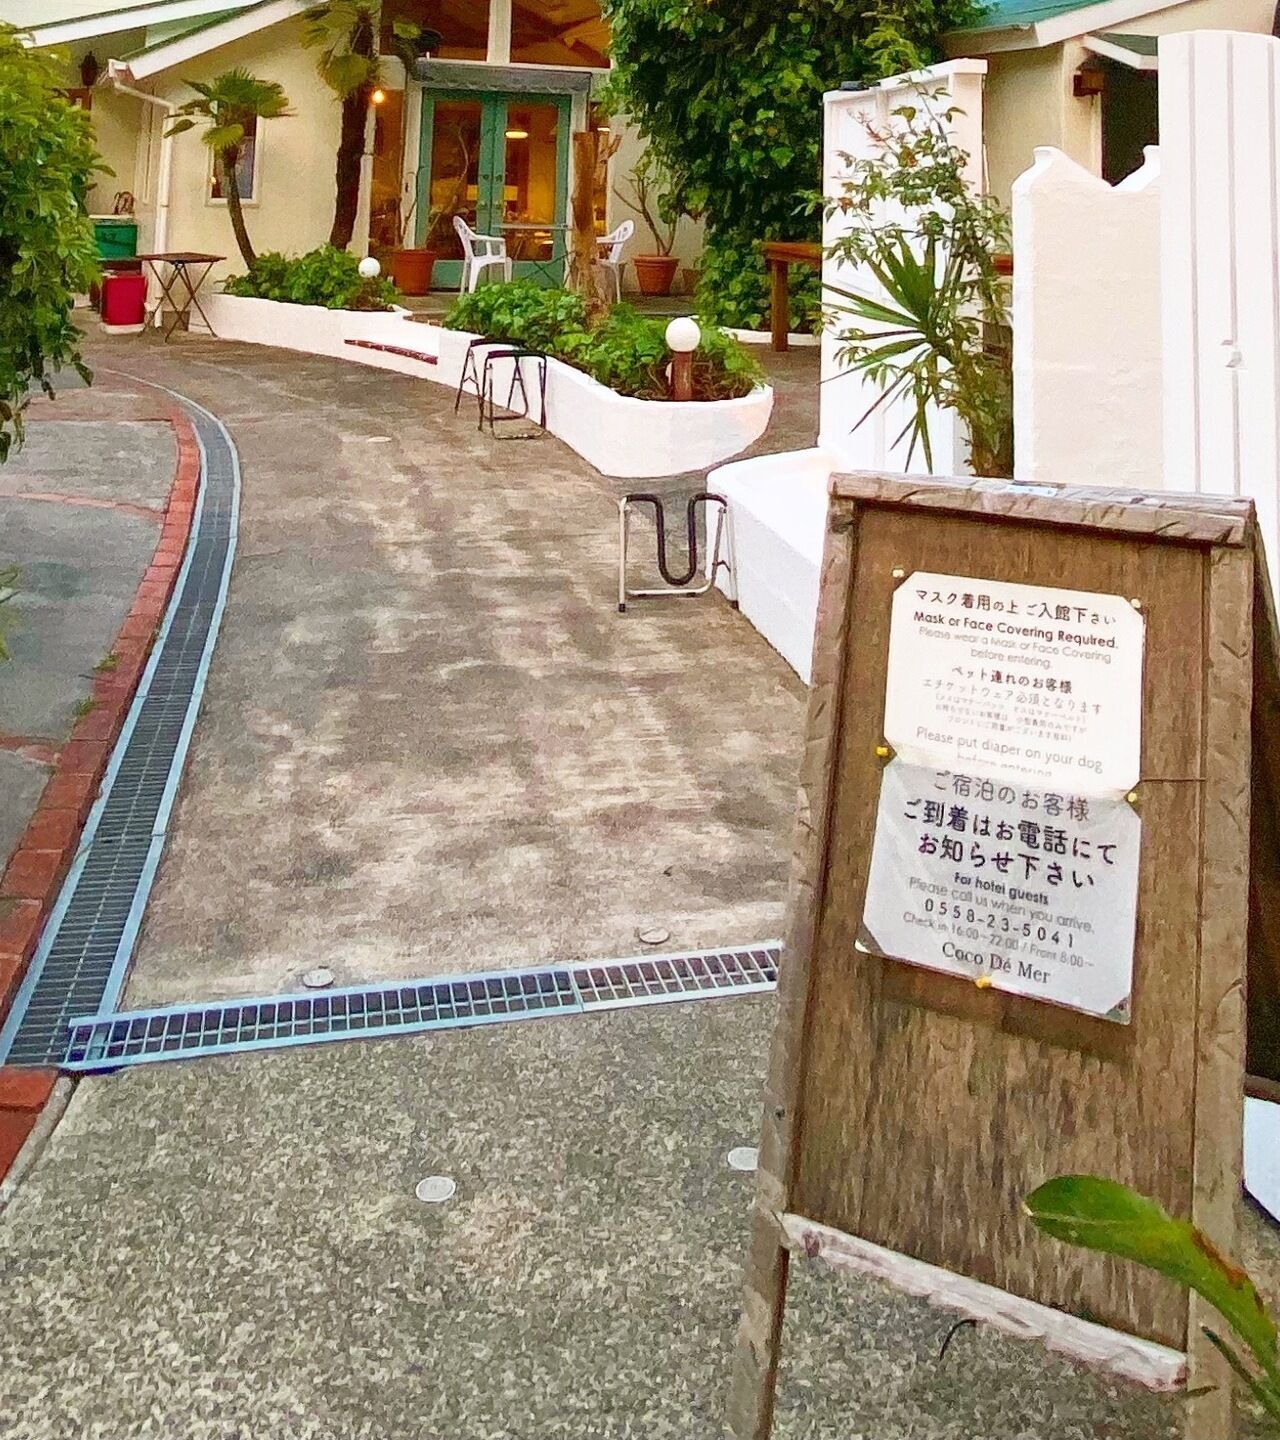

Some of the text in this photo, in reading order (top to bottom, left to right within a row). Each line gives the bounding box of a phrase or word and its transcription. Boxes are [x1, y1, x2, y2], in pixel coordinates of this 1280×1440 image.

[914, 611, 1119, 649] Mask or Face Covering Required.
[919, 626, 951, 640] Please
[954, 632, 977, 643] wear
[1033, 641, 1059, 655] Face
[1062, 646, 1111, 664] Covering
[971, 648, 1004, 662] before
[916, 726, 953, 744] Please
[957, 735, 977, 750] put
[982, 739, 1020, 756] diaper
[1025, 748, 1041, 759] on
[1045, 752, 1073, 765] your
[1078, 755, 1103, 774] dog
[935, 770, 1089, 822] ご宿泊のお客様
[904, 799, 1117, 865] ご到着はお電話にて
[919, 834, 1094, 888] お知らせ下さい
[909, 876, 948, 897] Please
[951, 888, 973, 903] call
[975, 896, 988, 907] us
[991, 899, 1026, 916] when
[1030, 910, 1053, 923] you
[954, 871, 1049, 906] For hotel guests
[903, 911, 934, 929] Check
[942, 941, 984, 965] Coco
[1018, 960, 1051, 984] Mer
